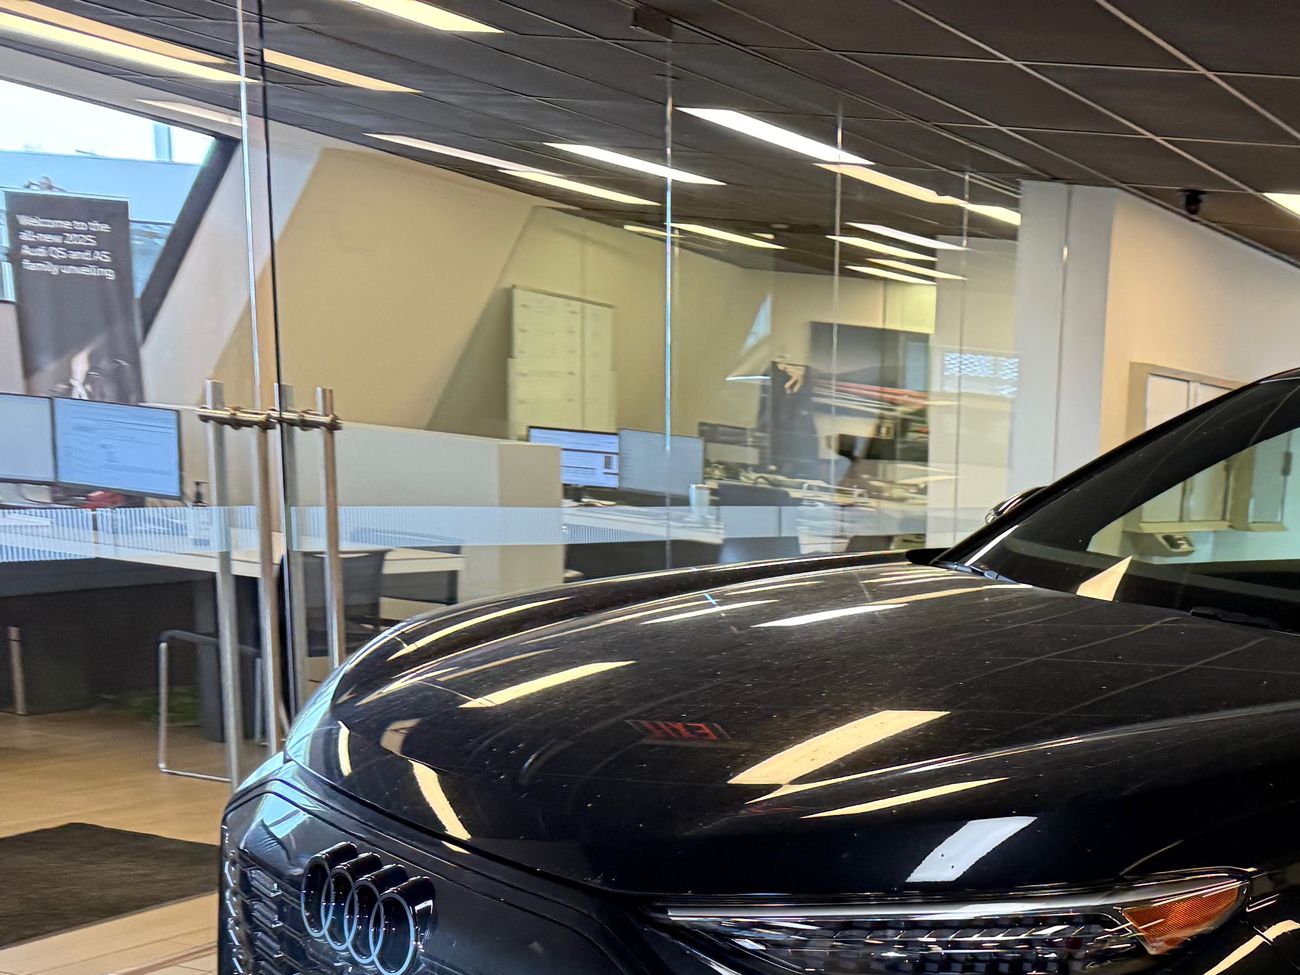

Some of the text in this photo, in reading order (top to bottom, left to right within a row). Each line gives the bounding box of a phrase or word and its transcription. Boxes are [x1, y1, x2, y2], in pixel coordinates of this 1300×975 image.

[16, 214, 112, 233] Welcome to the
[20, 244, 48, 257] Audi
[67, 248, 92, 261] and
[60, 264, 116, 281] unveiling
